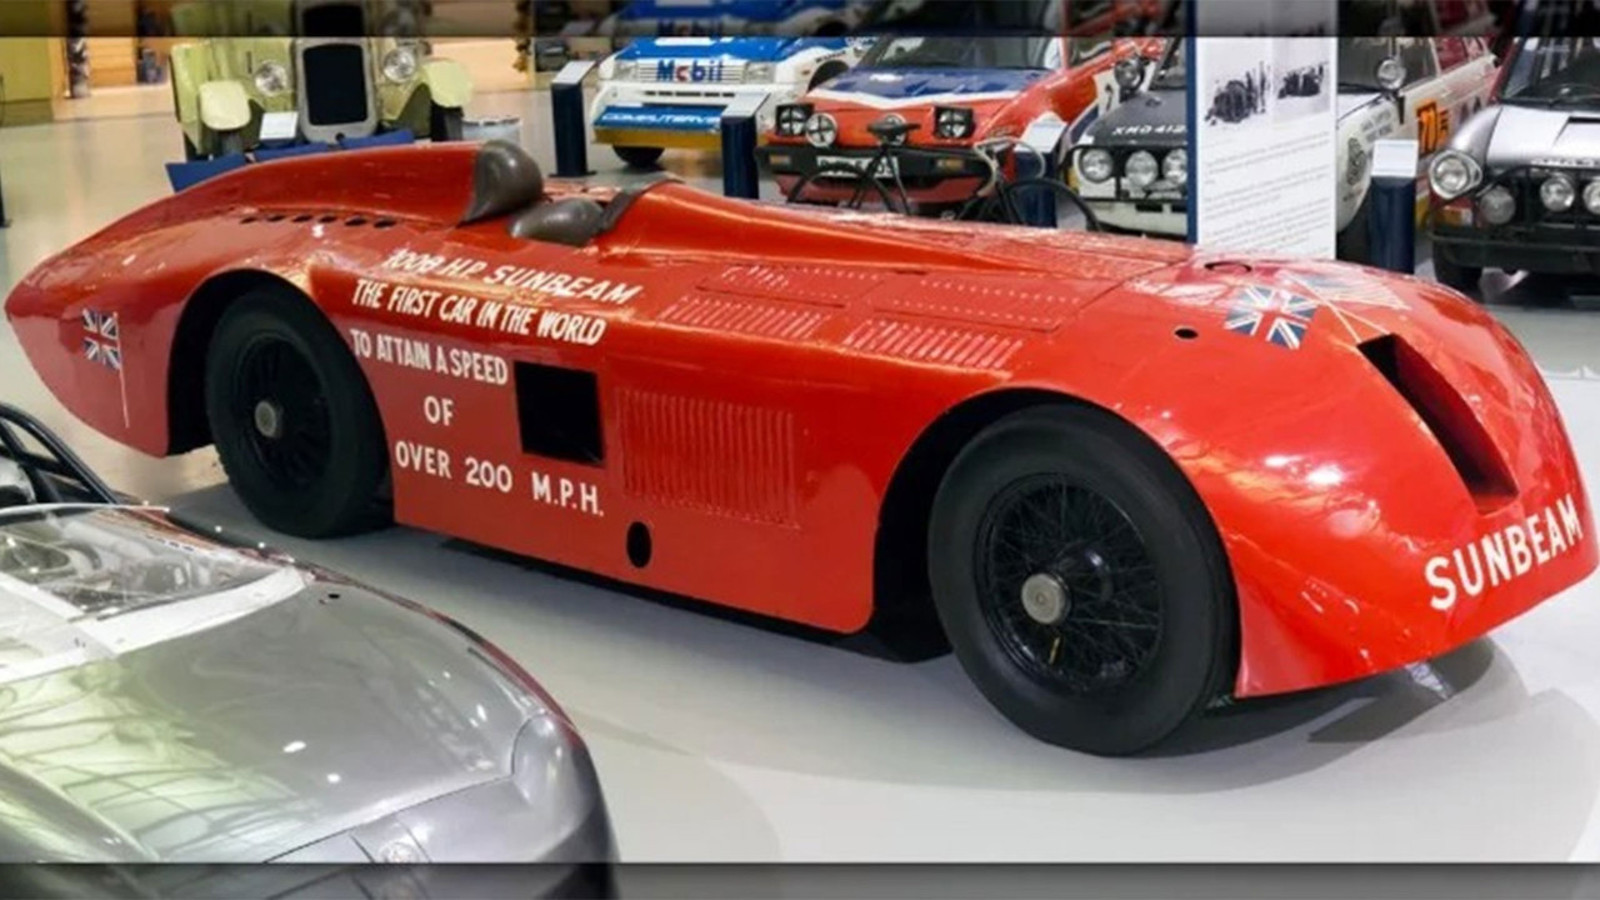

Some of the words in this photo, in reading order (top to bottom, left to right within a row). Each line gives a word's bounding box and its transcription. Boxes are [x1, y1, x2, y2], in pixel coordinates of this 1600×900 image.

[656, 58, 723, 82] Mobil
[352, 279, 385, 306] THE
[387, 286, 435, 318] FIRST
[439, 294, 475, 322] CAR
[476, 302, 500, 328] IN
[500, 305, 530, 336] THE
[537, 309, 607, 346] WORLD
[483, 264, 643, 305] SUNBEAM
[350, 329, 373, 357] TO
[376, 335, 432, 372] ATTAIN
[436, 346, 449, 372] A
[450, 348, 509, 386] SPEED
[424, 395, 454, 426] OF
[395, 441, 452, 479] OVER
[465, 457, 513, 494] 200
[531, 471, 605, 517] M.P.H.
[1424, 492, 1584, 611] SUNBEAM
